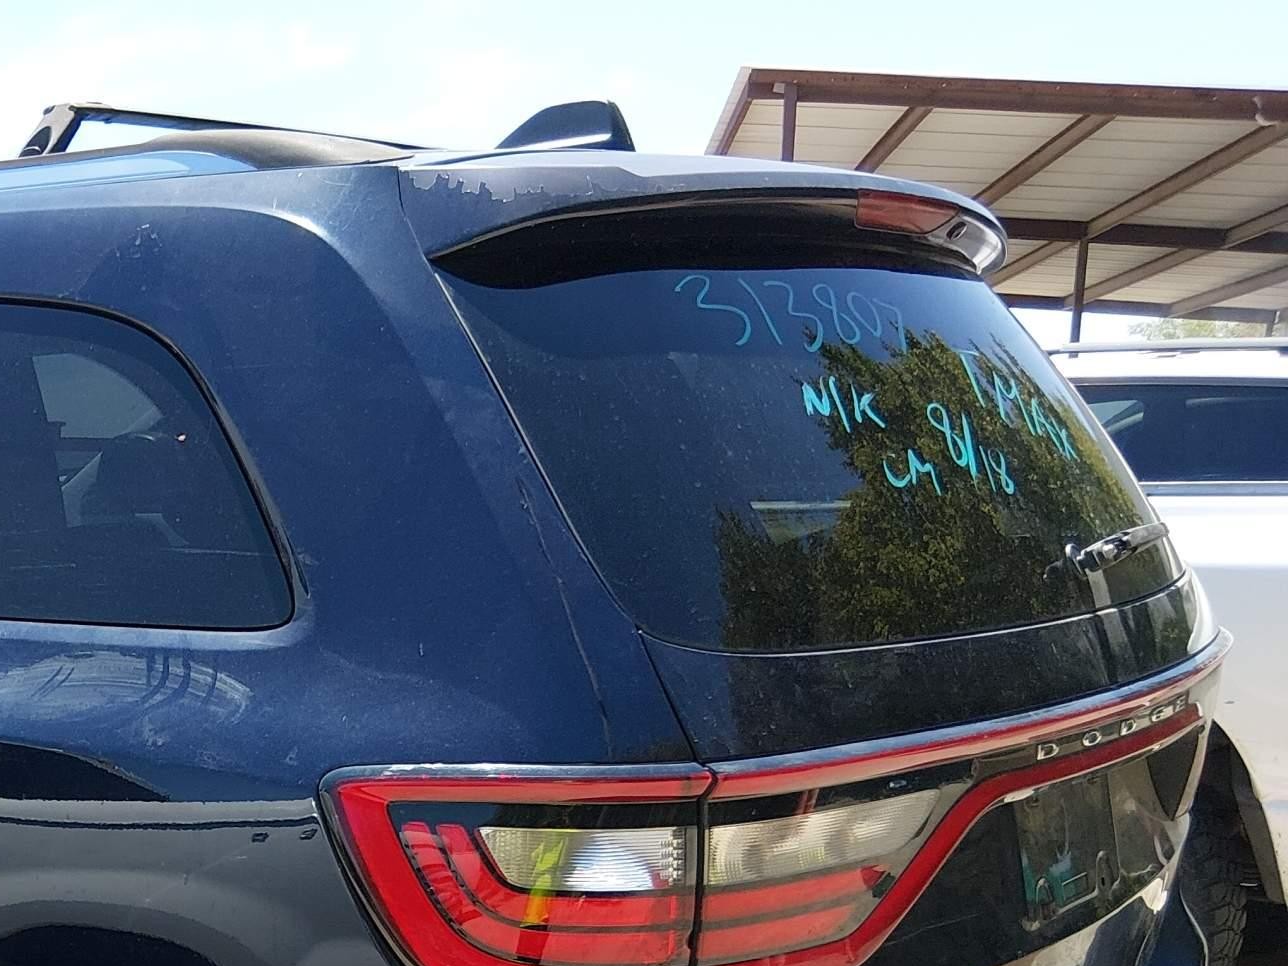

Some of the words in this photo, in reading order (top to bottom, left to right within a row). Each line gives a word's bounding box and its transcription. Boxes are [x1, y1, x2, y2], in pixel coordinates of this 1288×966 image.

[674, 274, 907, 353] 313807
[801, 375, 886, 433] N/K
[1036, 695, 1188, 761] DODGE
